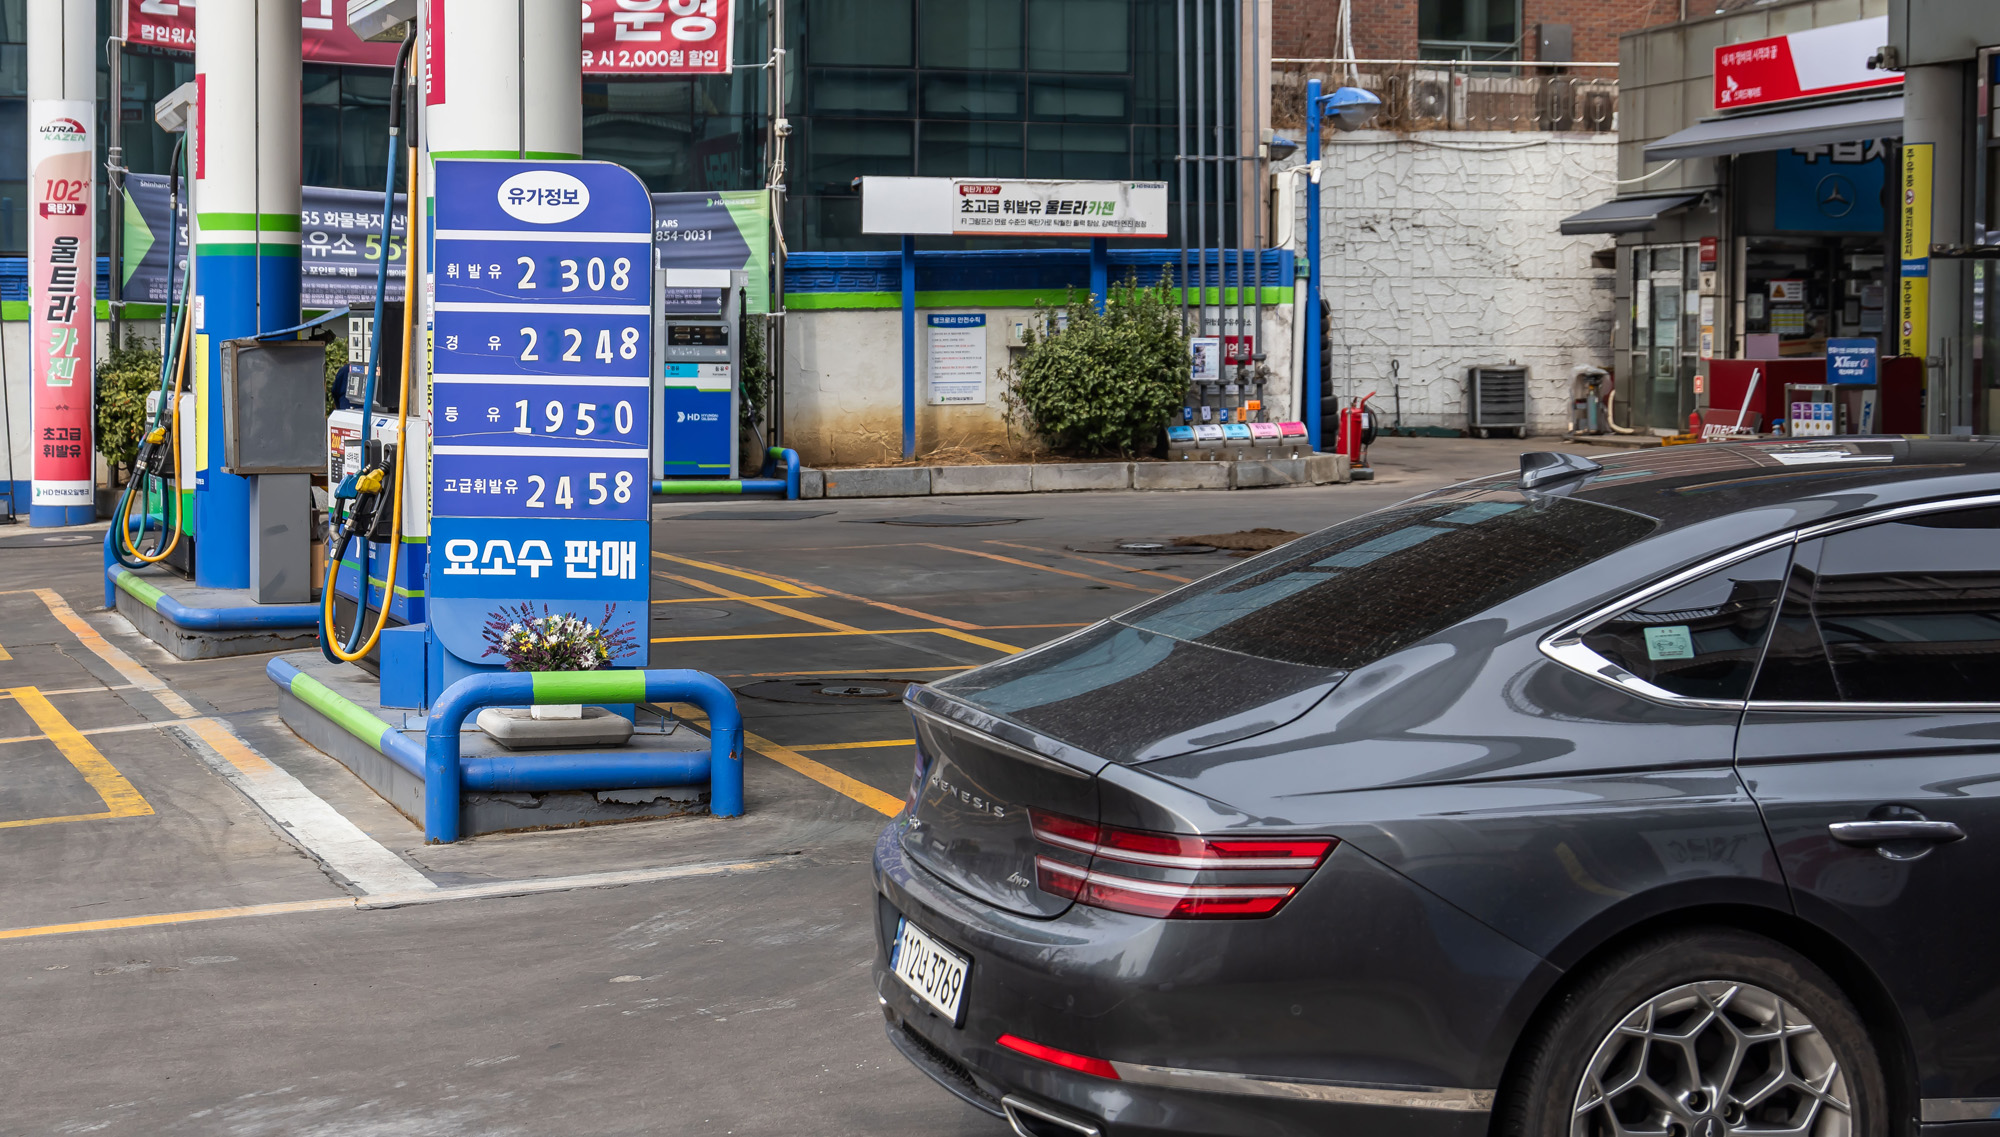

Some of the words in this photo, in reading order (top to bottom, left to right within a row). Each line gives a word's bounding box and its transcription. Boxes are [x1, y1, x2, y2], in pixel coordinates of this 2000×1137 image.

[613, 0, 717, 41] 운영
[599, 50, 613, 66] 시
[618, 50, 683, 67] 2,000원
[688, 50, 718, 66] 할인
[1721, 90, 1731, 103] SK
[44, 133, 87, 142] KAZEN
[507, 187, 580, 206] 유가정보
[47, 203, 76, 214] 옥탄가
[961, 199, 1000, 213] 초고급
[1003, 199, 1042, 214] 휘발유
[323, 211, 384, 229] 화물복지
[391, 214, 407, 230] 신
[661, 219, 678, 228] ARS
[302, 231, 357, 257] 유소
[364, 234, 407, 261] 55
[310, 266, 336, 275] 포인트
[46, 236, 81, 387] 울트라카젠
[513, 400, 633, 436] 1950
[687, 413, 700, 421] HD
[43, 427, 82, 441] 초고급
[43, 444, 82, 458] 휘발유
[443, 478, 519, 495] 고급휘발유
[443, 538, 553, 578] 요소수
[564, 540, 636, 580] 판매
[931, 775, 1006, 818] GENESIS
